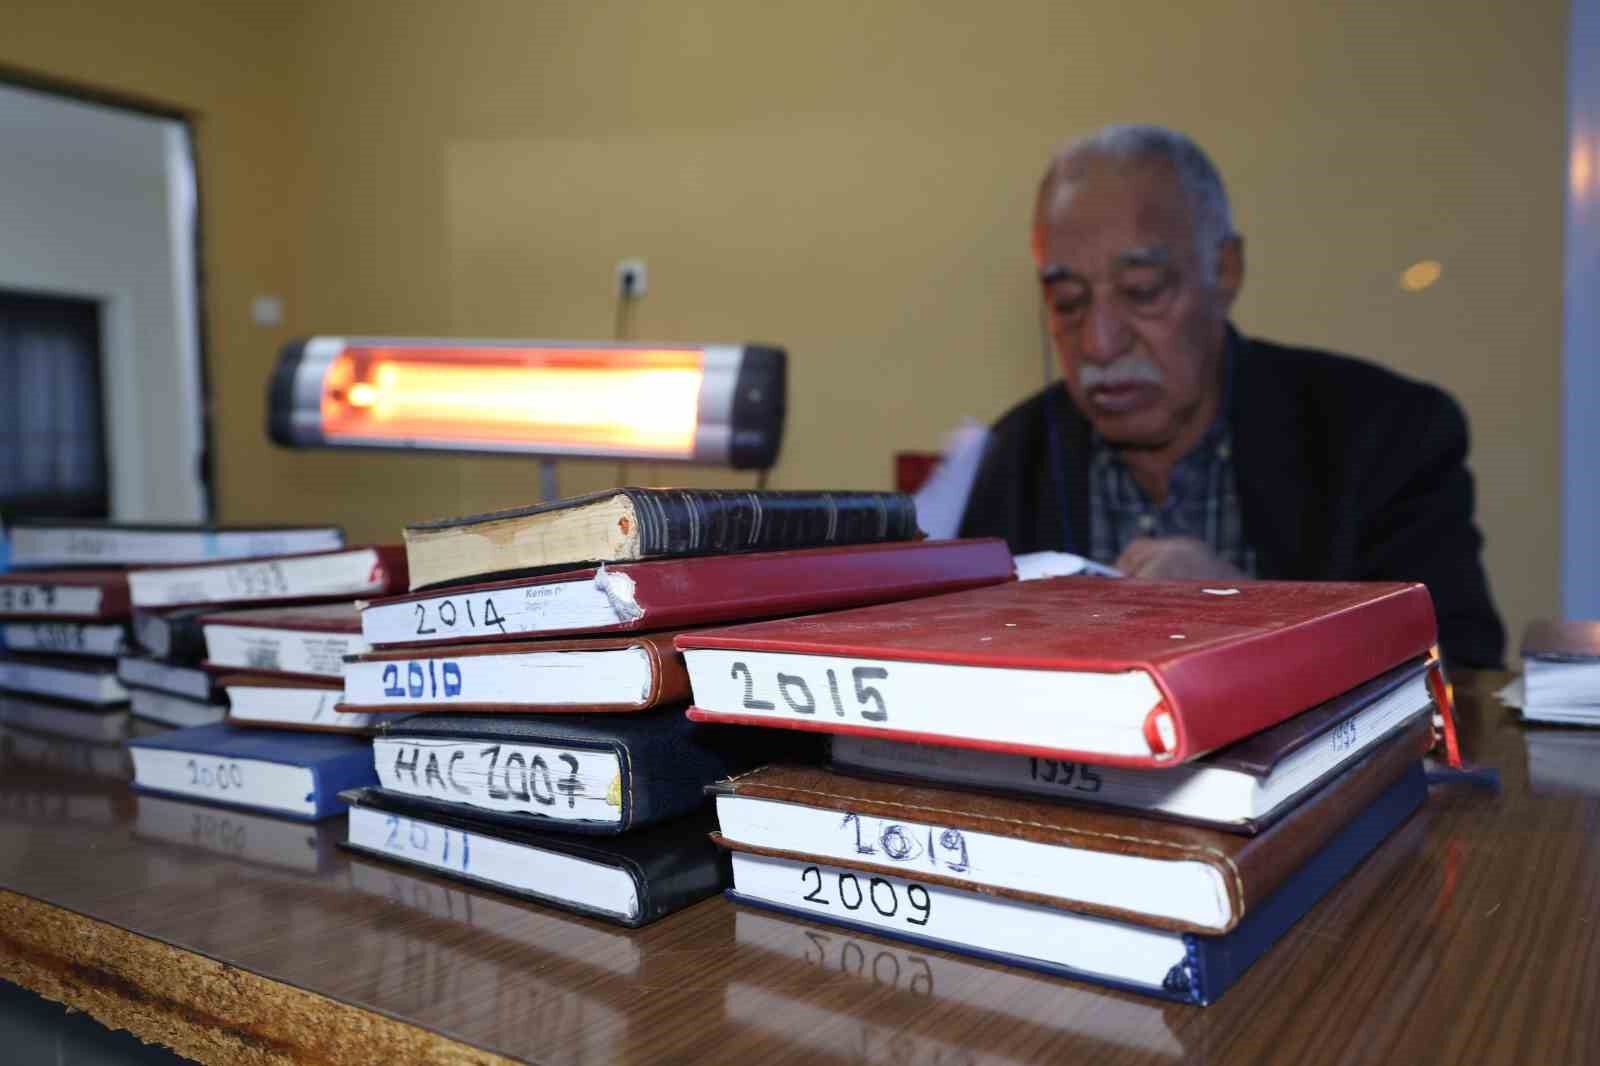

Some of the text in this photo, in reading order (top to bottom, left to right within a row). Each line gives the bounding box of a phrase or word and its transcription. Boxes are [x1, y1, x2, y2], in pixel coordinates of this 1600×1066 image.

[414, 598, 507, 642] 2014
[382, 661, 462, 699] 2010
[731, 661, 889, 722] 2015
[187, 759, 242, 789] 2000
[393, 747, 584, 808] HAC 2007
[1028, 757, 1101, 792] 1995
[384, 814, 470, 871] 2011
[840, 811, 970, 874] 2019
[801, 866, 932, 926] 2009
